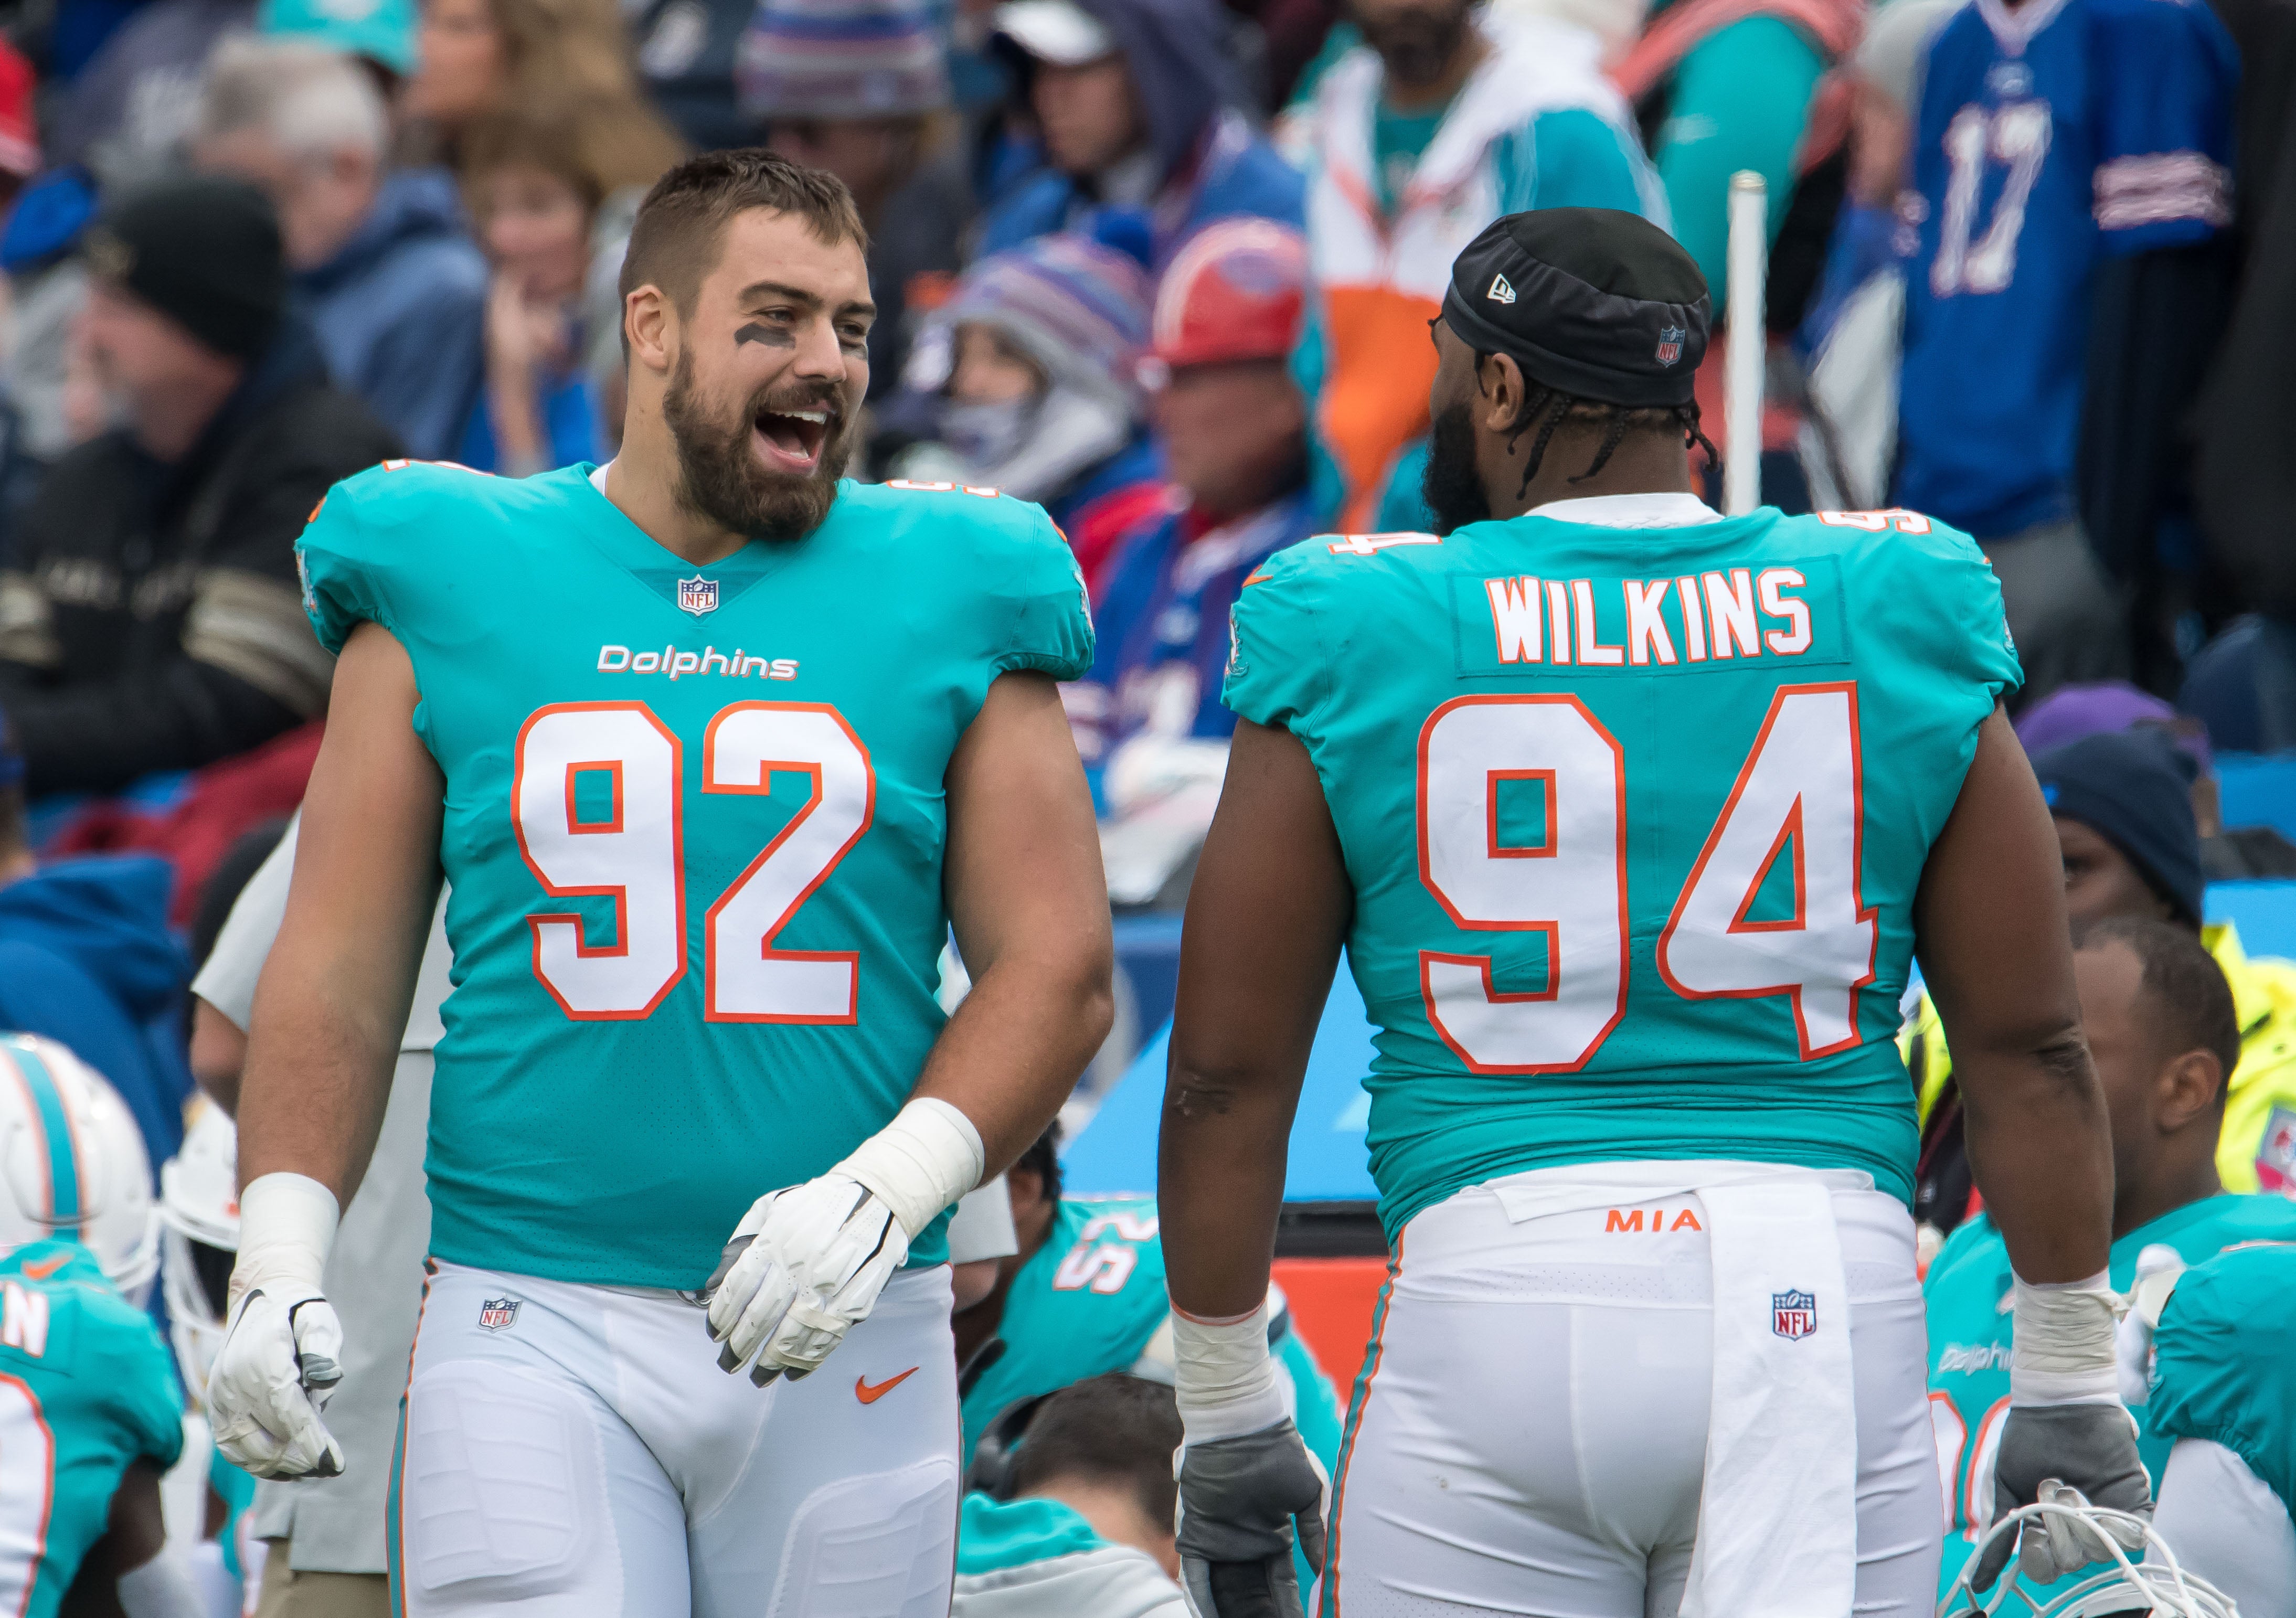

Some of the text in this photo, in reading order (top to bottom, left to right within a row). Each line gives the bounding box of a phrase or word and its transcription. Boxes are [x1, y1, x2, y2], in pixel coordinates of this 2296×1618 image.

[1931, 100, 2054, 298] 17
[685, 593, 713, 608] NFL
[1485, 568, 1813, 666] WILKINS
[597, 644, 801, 681] Dolphins
[511, 700, 876, 1025] 92
[1417, 680, 1879, 1074] 94
[1605, 1209, 1703, 1233] MIA
[482, 1311, 509, 1326] NFL
[1777, 1312, 1814, 1336] NFL
